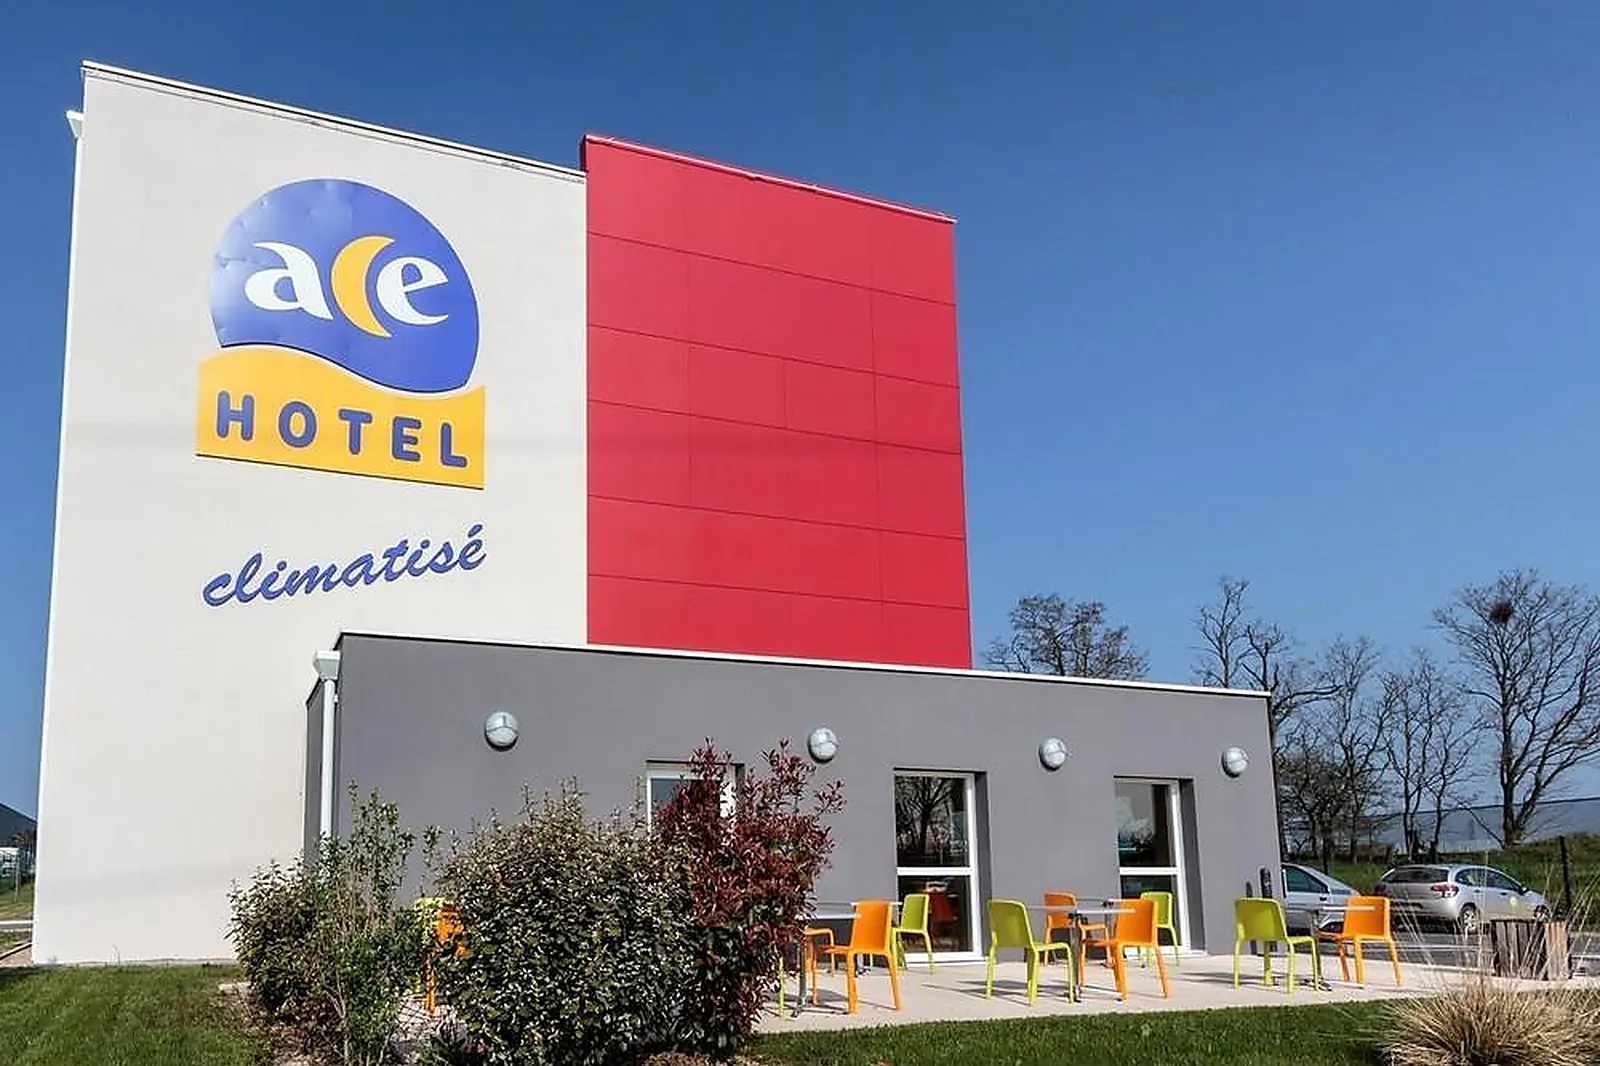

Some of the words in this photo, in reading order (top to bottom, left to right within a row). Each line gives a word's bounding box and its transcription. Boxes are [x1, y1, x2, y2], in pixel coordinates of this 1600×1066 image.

[244, 235, 449, 338] ace
[216, 391, 468, 468] HOTEL
[202, 523, 487, 607] climatisé
